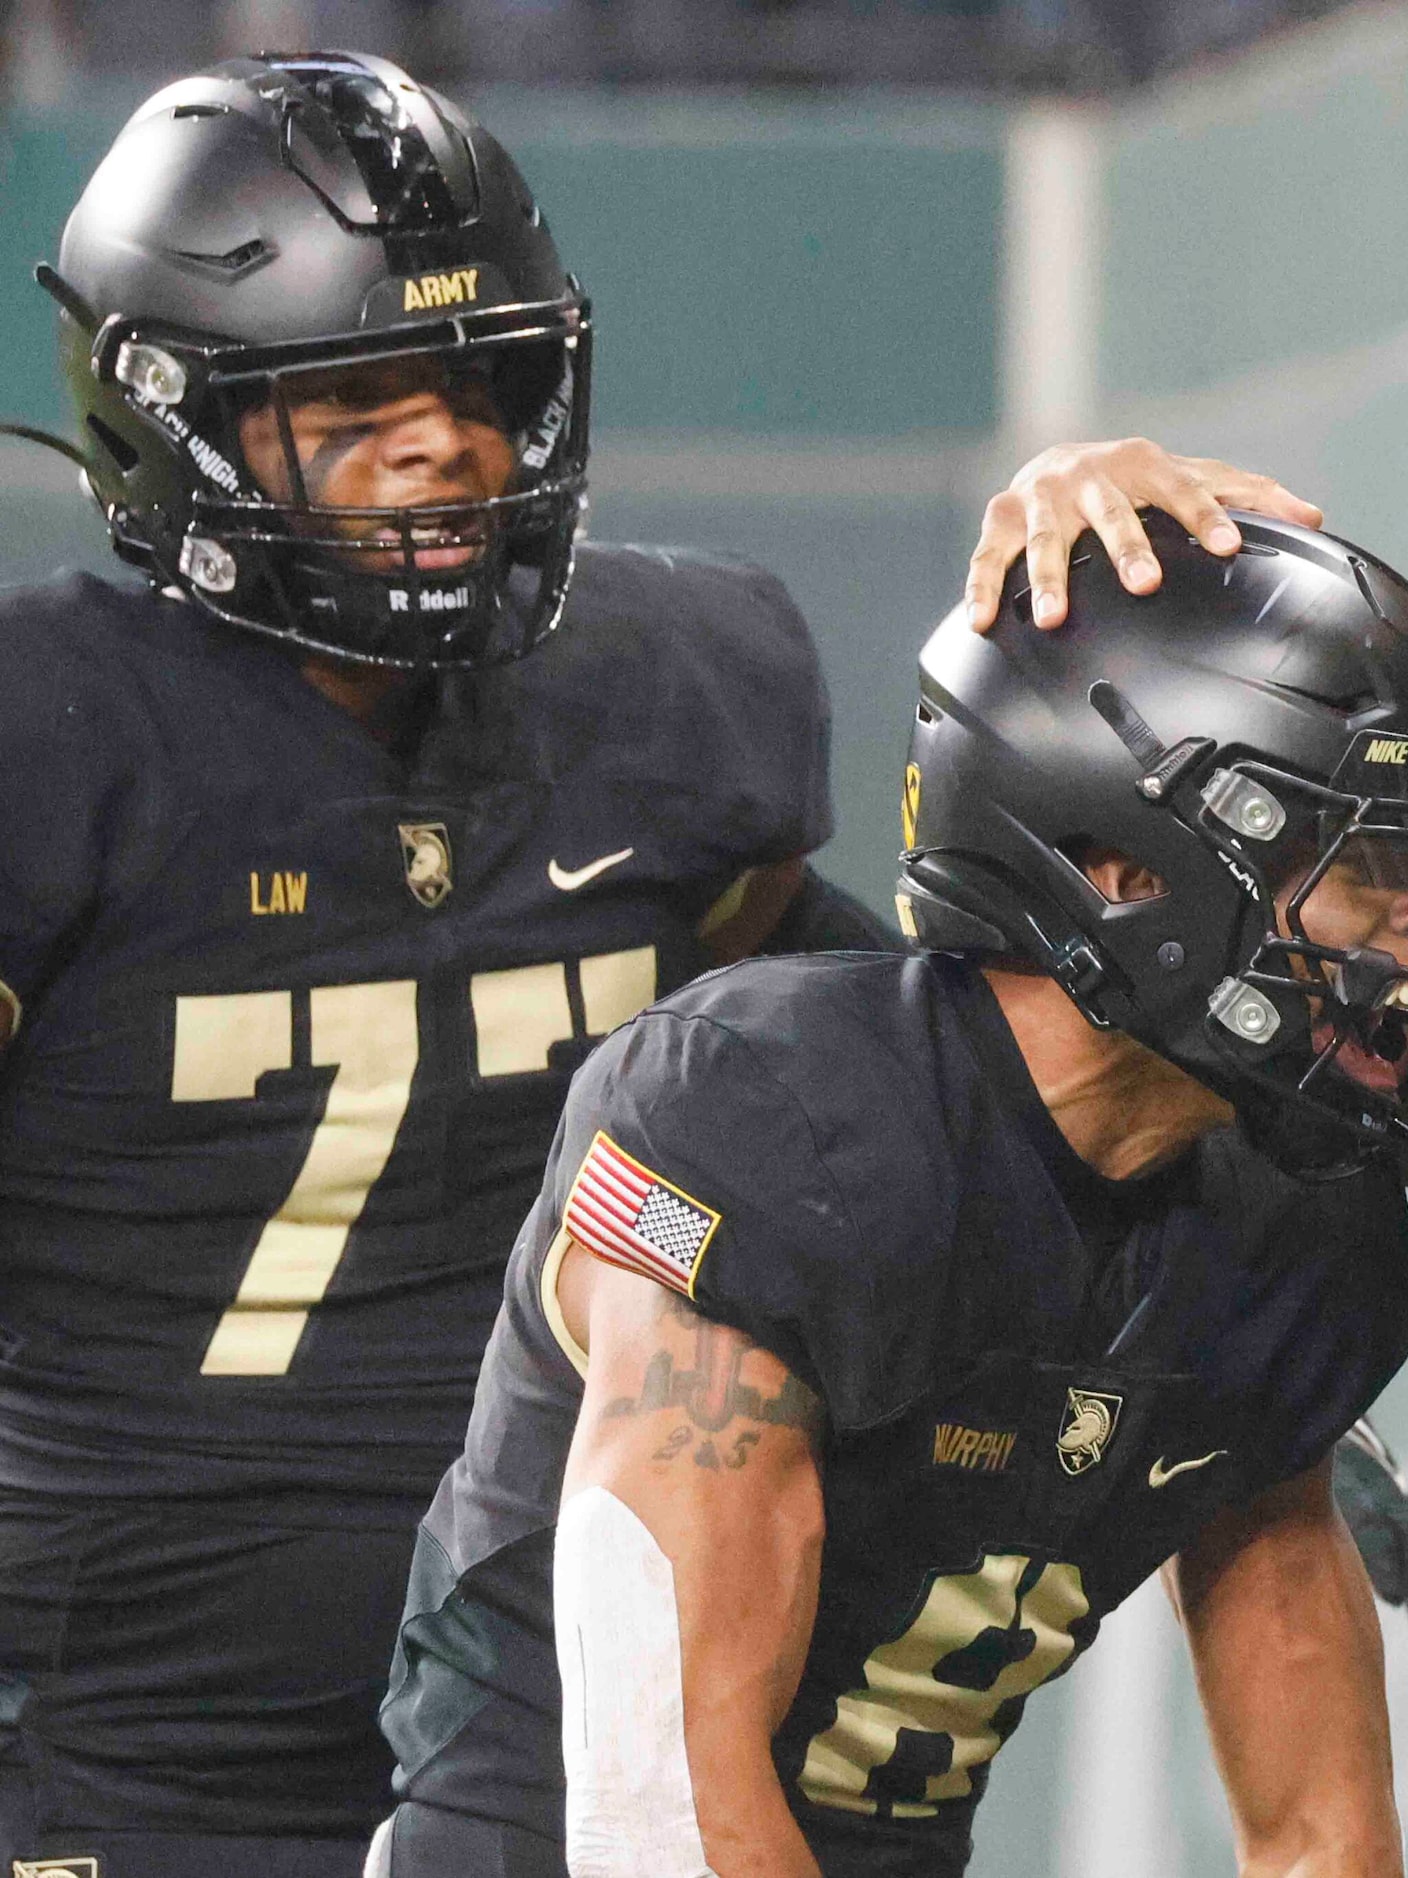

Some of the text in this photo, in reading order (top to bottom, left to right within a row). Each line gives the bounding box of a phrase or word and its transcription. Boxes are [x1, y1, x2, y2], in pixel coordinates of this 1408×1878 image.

[404, 268, 478, 313] ARMY
[388, 586, 469, 612] Rddell
[250, 870, 308, 916] LAW
[797, 1553, 1091, 1819] 8
